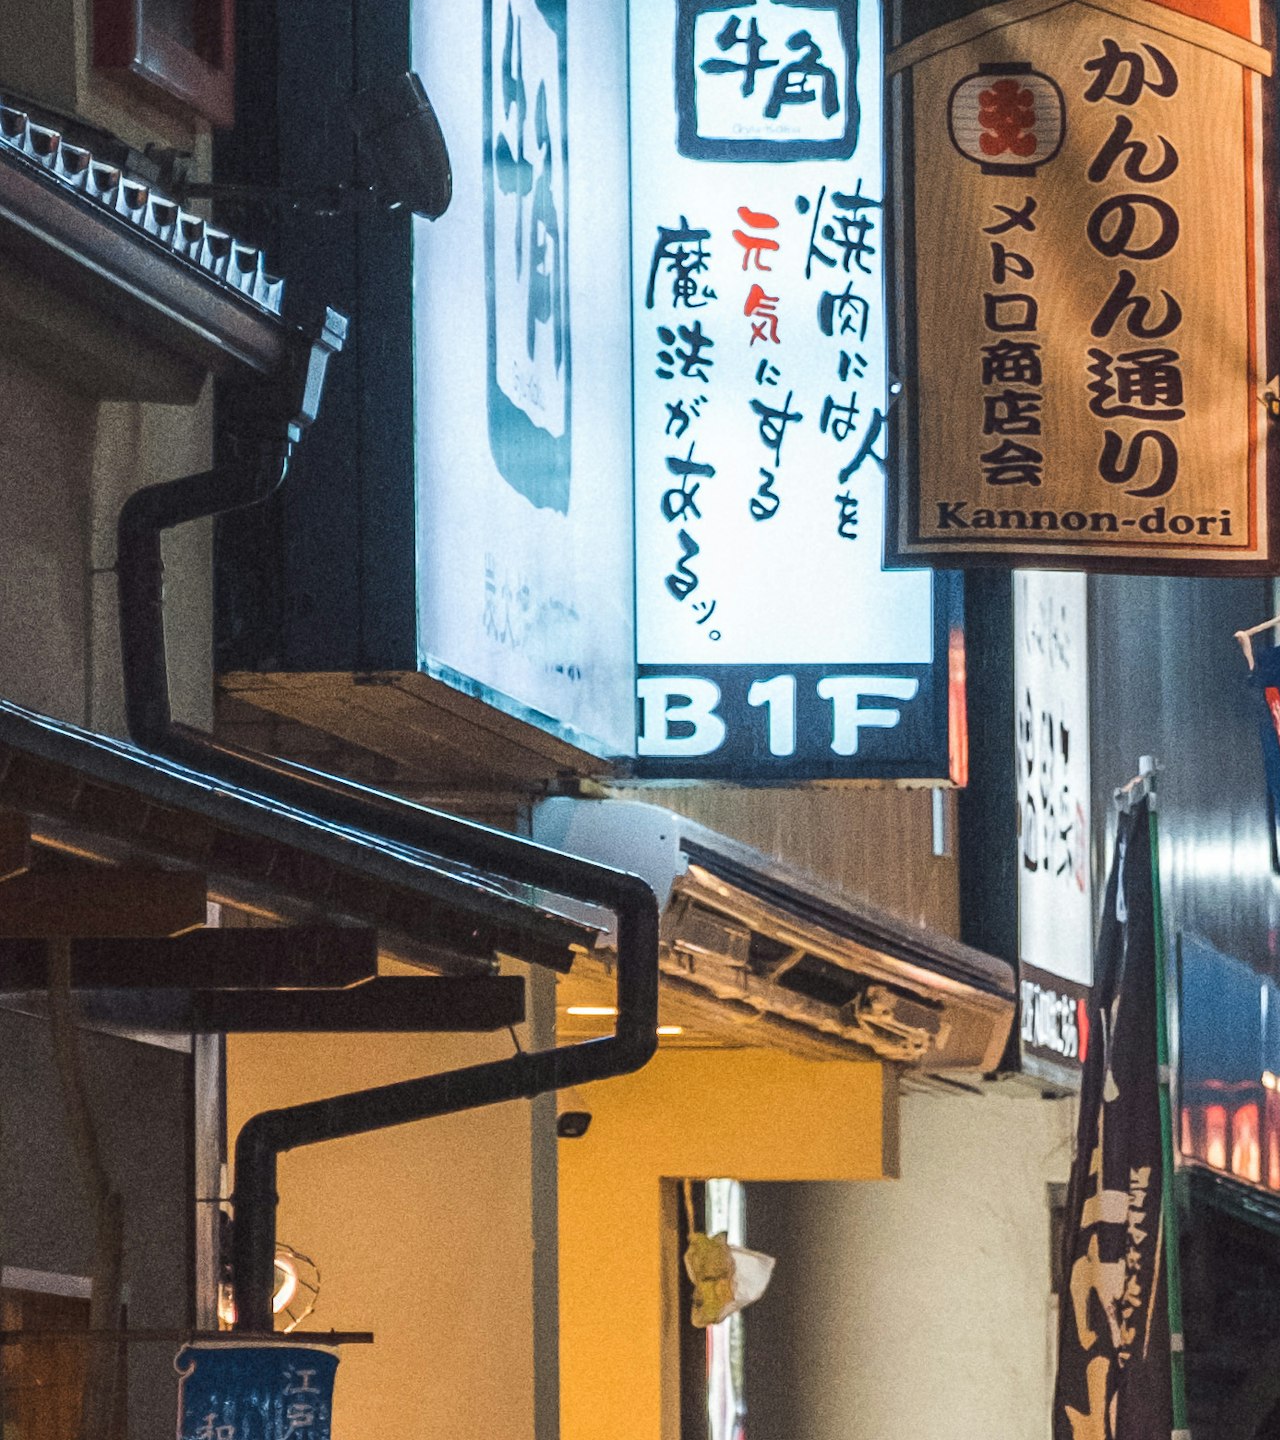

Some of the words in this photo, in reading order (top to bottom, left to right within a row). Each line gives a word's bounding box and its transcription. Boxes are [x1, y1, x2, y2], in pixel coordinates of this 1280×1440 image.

[699, 15, 841, 120] 牛角
[732, 206, 804, 523] 元気にする
[981, 196, 1045, 489] メトロ商店会
[1082, 36, 1187, 499] かんのん通り
[935, 501, 1235, 540] Kannon-dori
[638, 673, 920, 758] B1F
